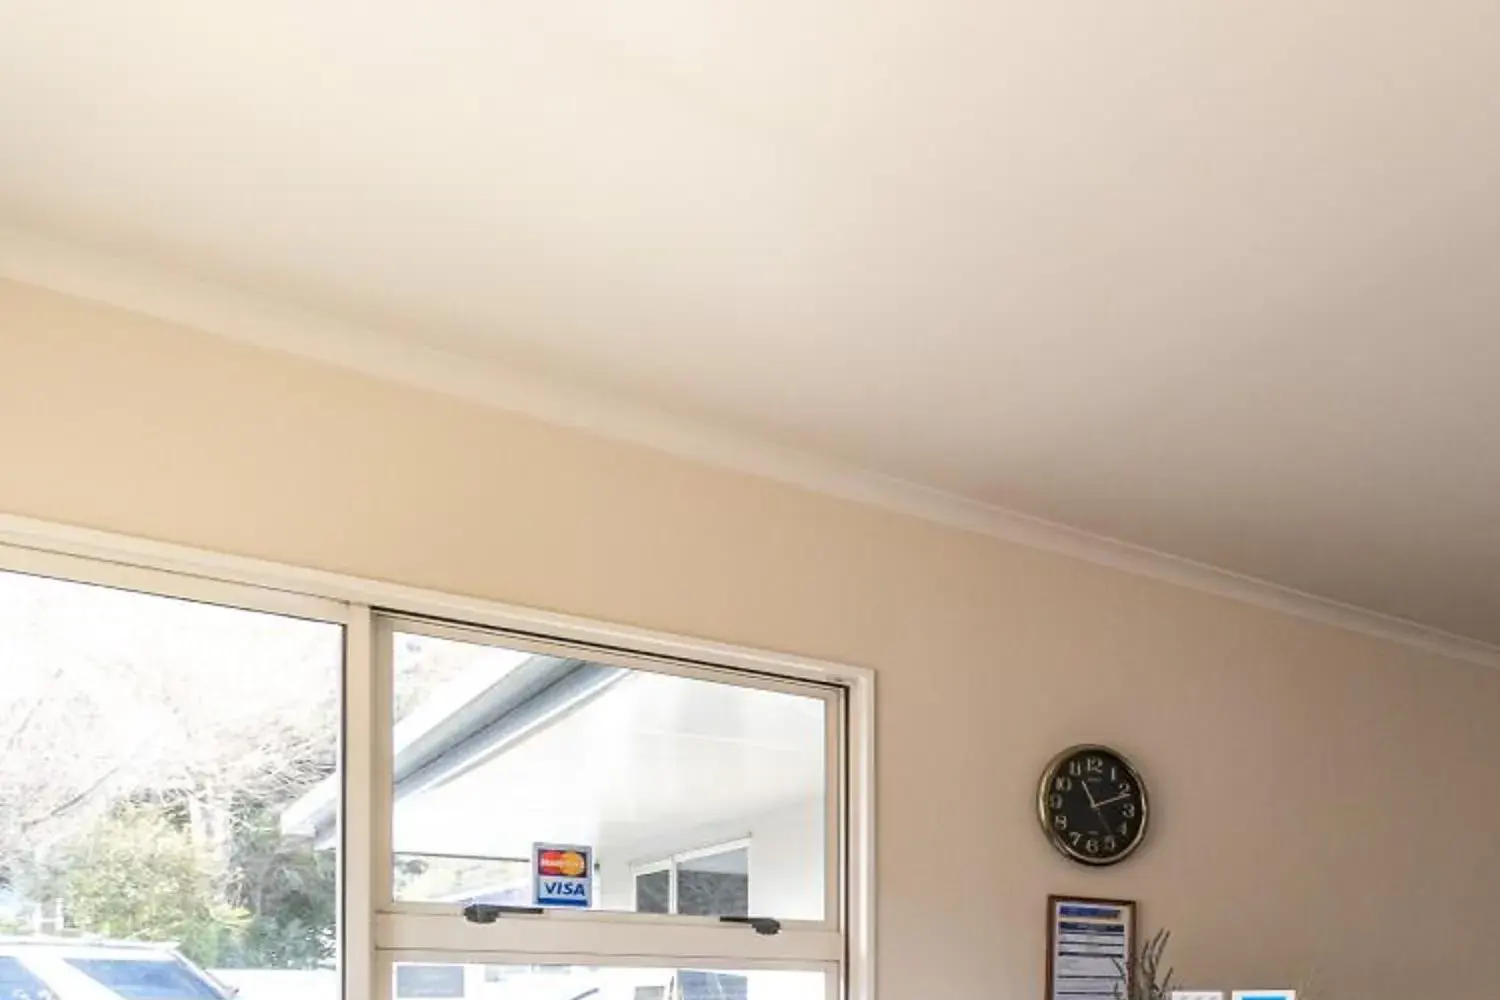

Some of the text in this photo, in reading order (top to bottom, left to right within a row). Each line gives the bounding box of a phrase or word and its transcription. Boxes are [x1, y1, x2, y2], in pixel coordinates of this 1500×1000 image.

[1086, 757, 1103, 774] 12
[1110, 767, 1117, 781] 1
[1122, 803, 1136, 819] 3
[1069, 831, 1084, 847] 7
[1086, 839, 1100, 854] 6
[544, 881, 585, 896] VISA
